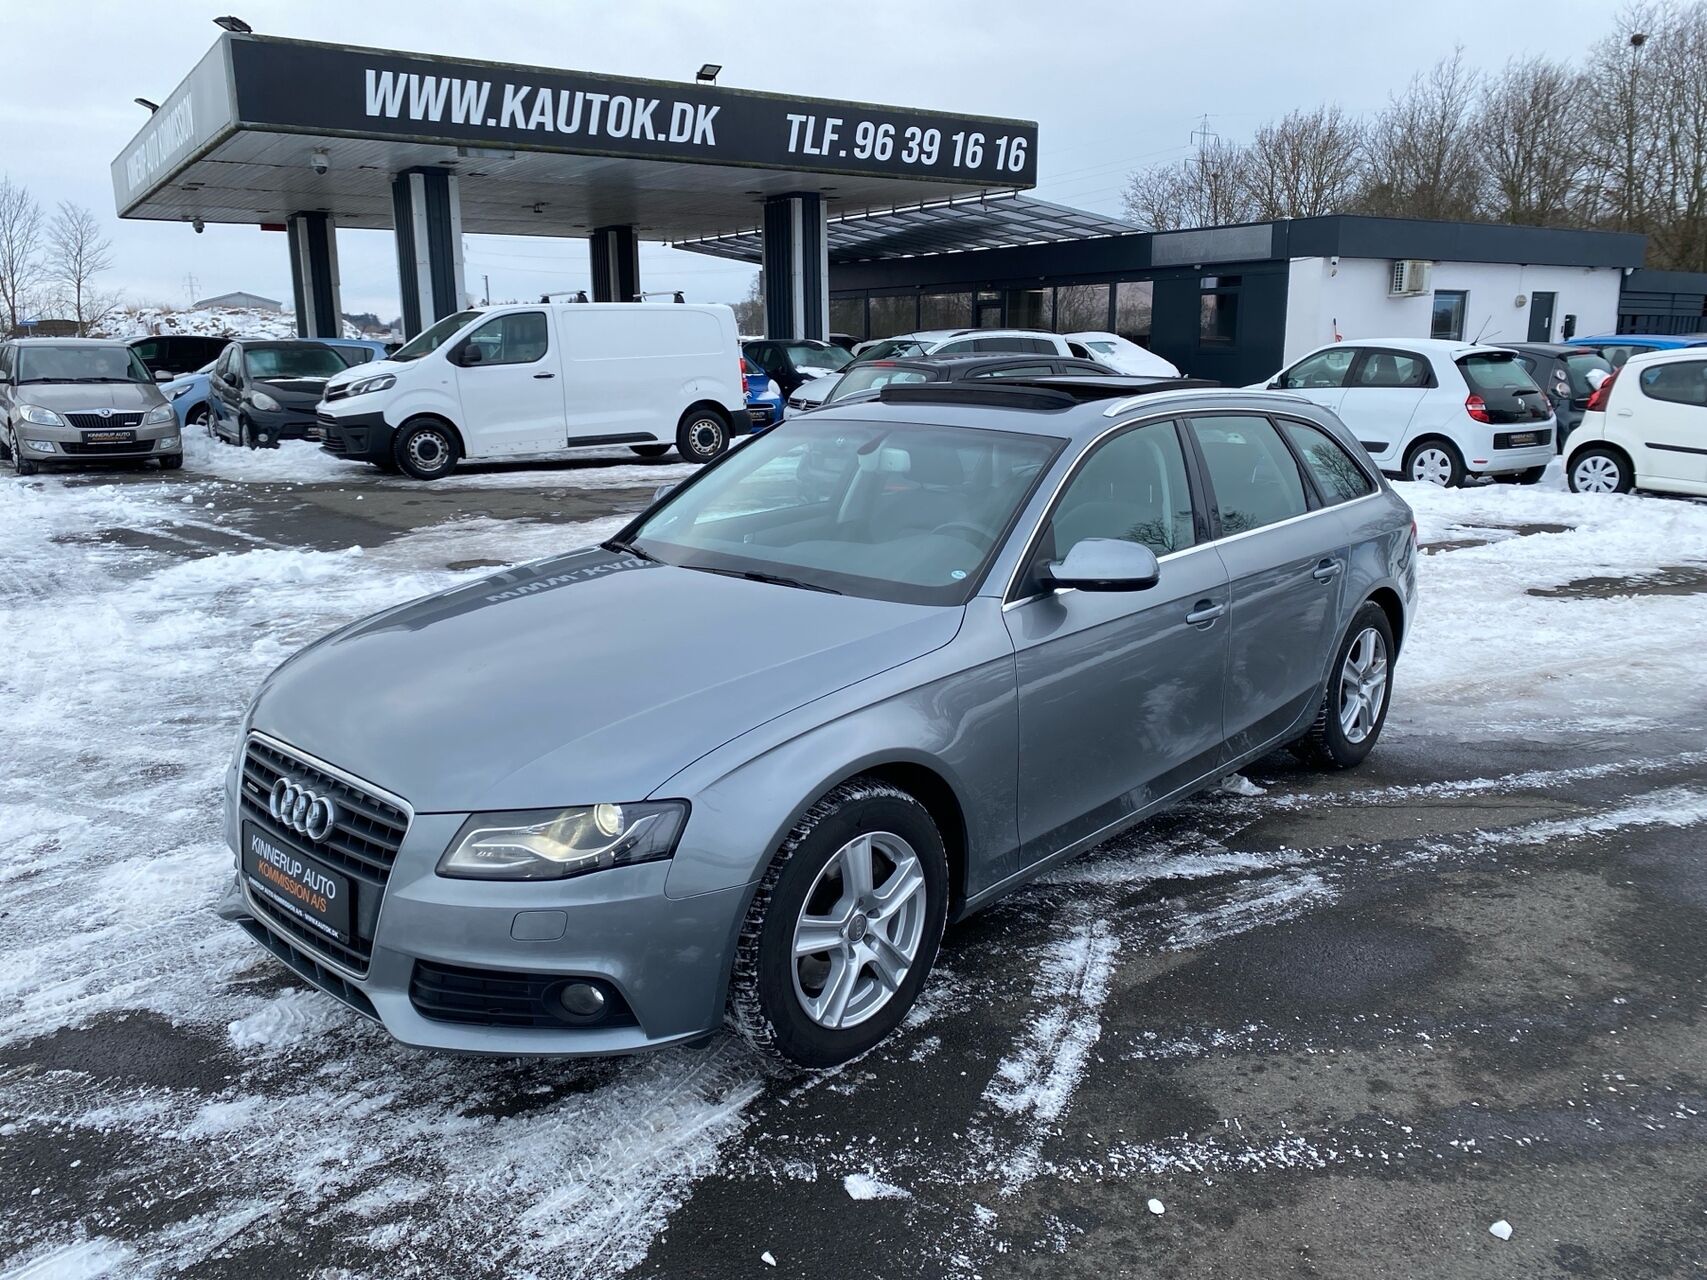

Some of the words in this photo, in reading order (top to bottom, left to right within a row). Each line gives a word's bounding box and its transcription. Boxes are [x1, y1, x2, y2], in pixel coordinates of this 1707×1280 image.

[364, 69, 721, 146] WWW.KAUTOK.DK
[786, 113, 847, 158] TLF.
[853, 121, 896, 161] 96
[901, 126, 942, 166] 39
[951, 131, 986, 169] 16
[995, 135, 1028, 172] 16
[251, 834, 302, 878] KINNERUP
[302, 868, 336, 900] AUTO
[258, 859, 311, 903] KOMMISSION
[310, 893, 327, 913] A/S
